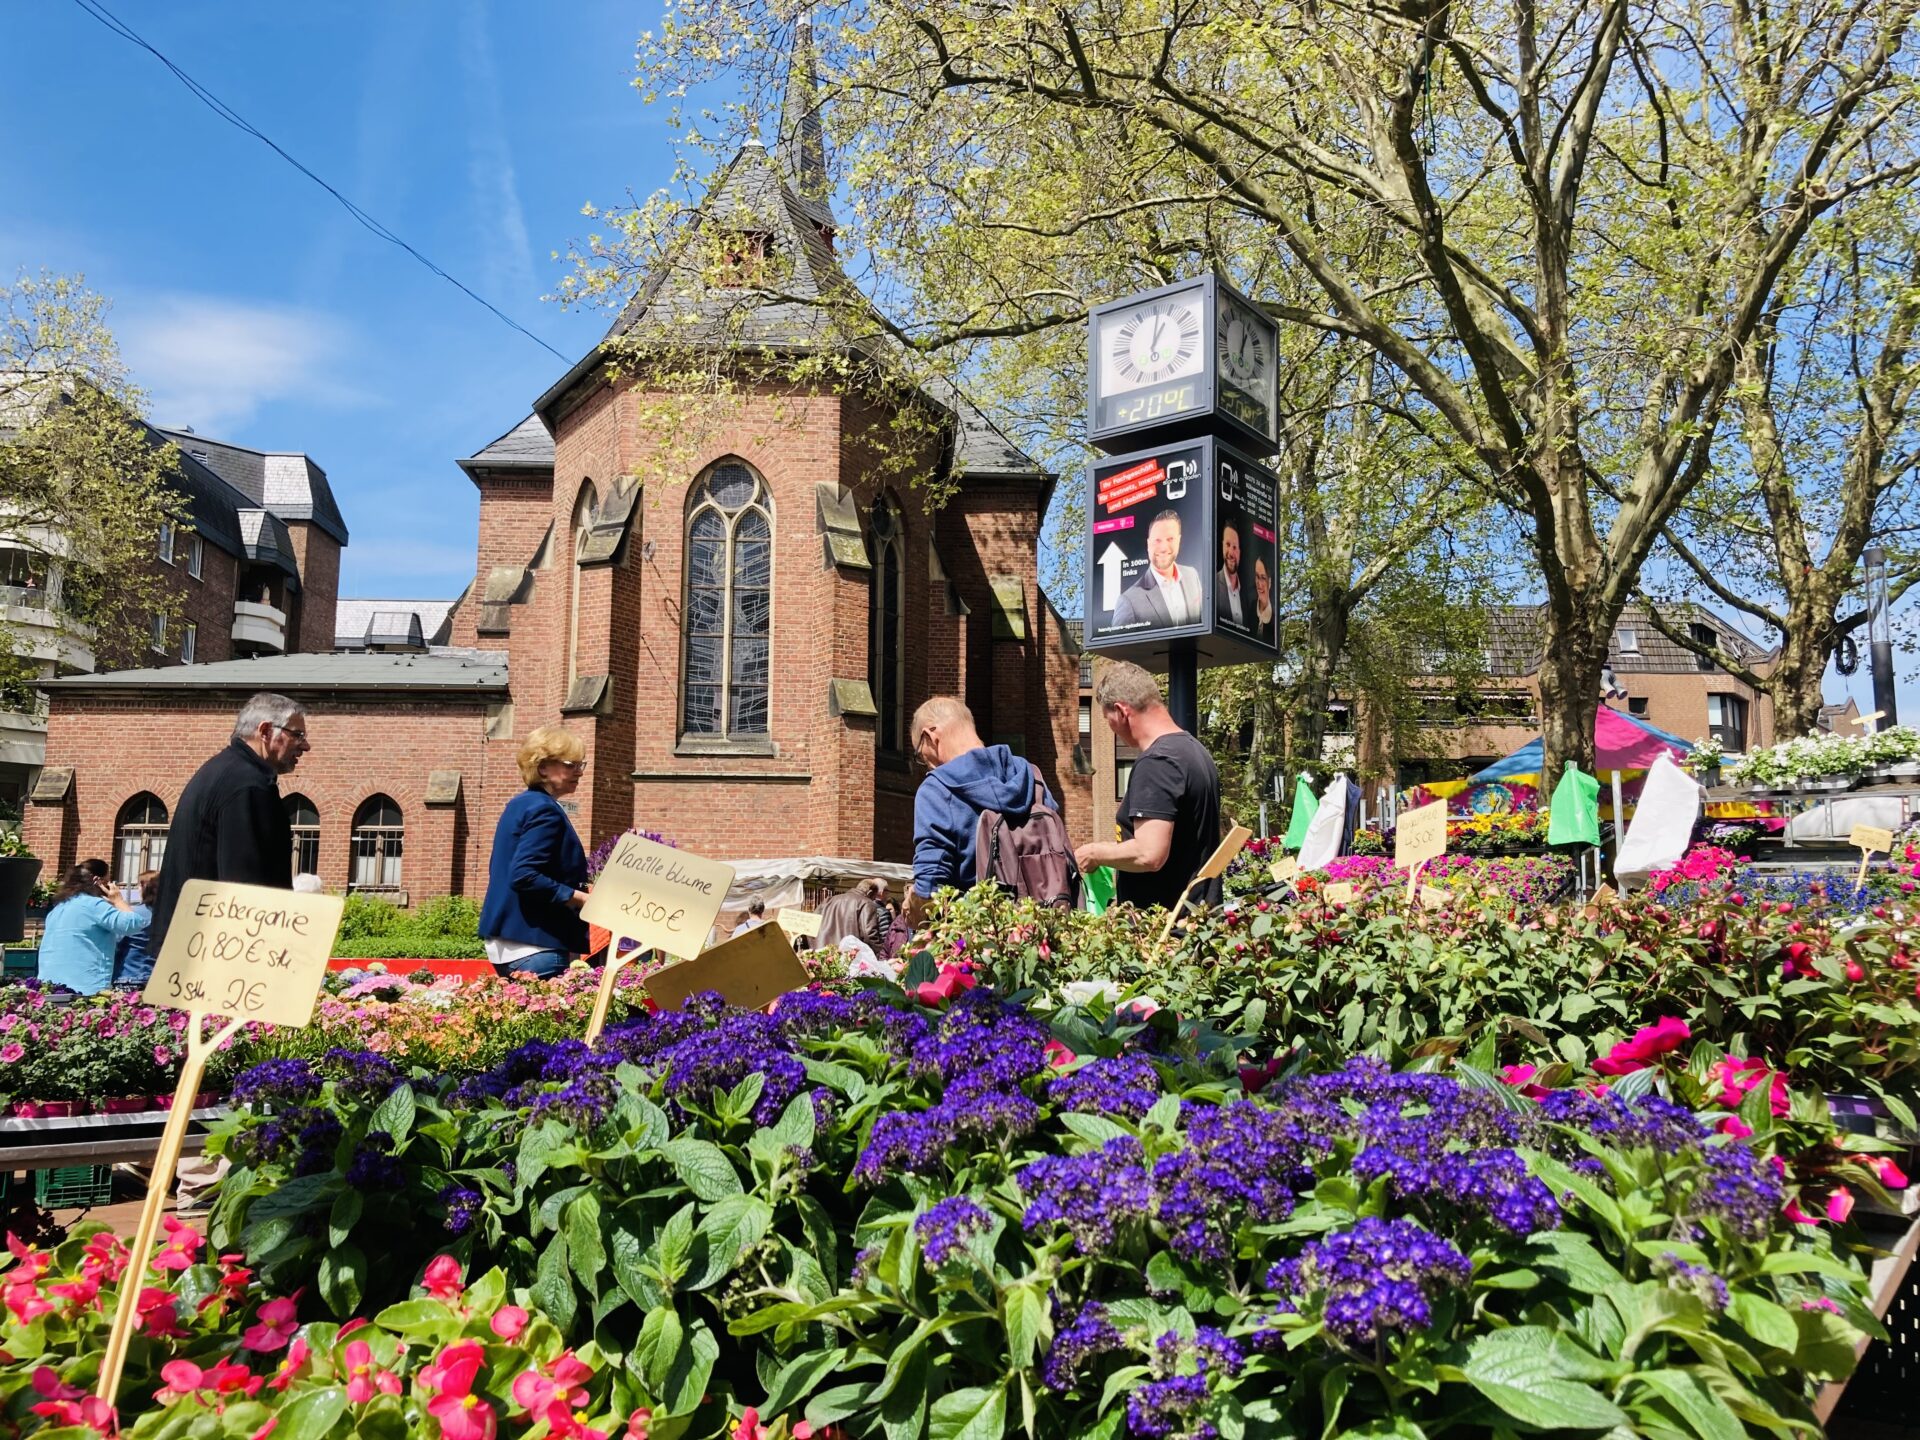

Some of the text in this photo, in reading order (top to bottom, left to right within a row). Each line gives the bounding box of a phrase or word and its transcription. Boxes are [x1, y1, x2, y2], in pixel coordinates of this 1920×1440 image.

[1138, 472, 1163, 487] Internet
[1123, 569, 1138, 577] links
[616, 842, 712, 895] Vanille blume
[621, 891, 685, 931] 2,50€
[222, 978, 267, 1012] 2€
